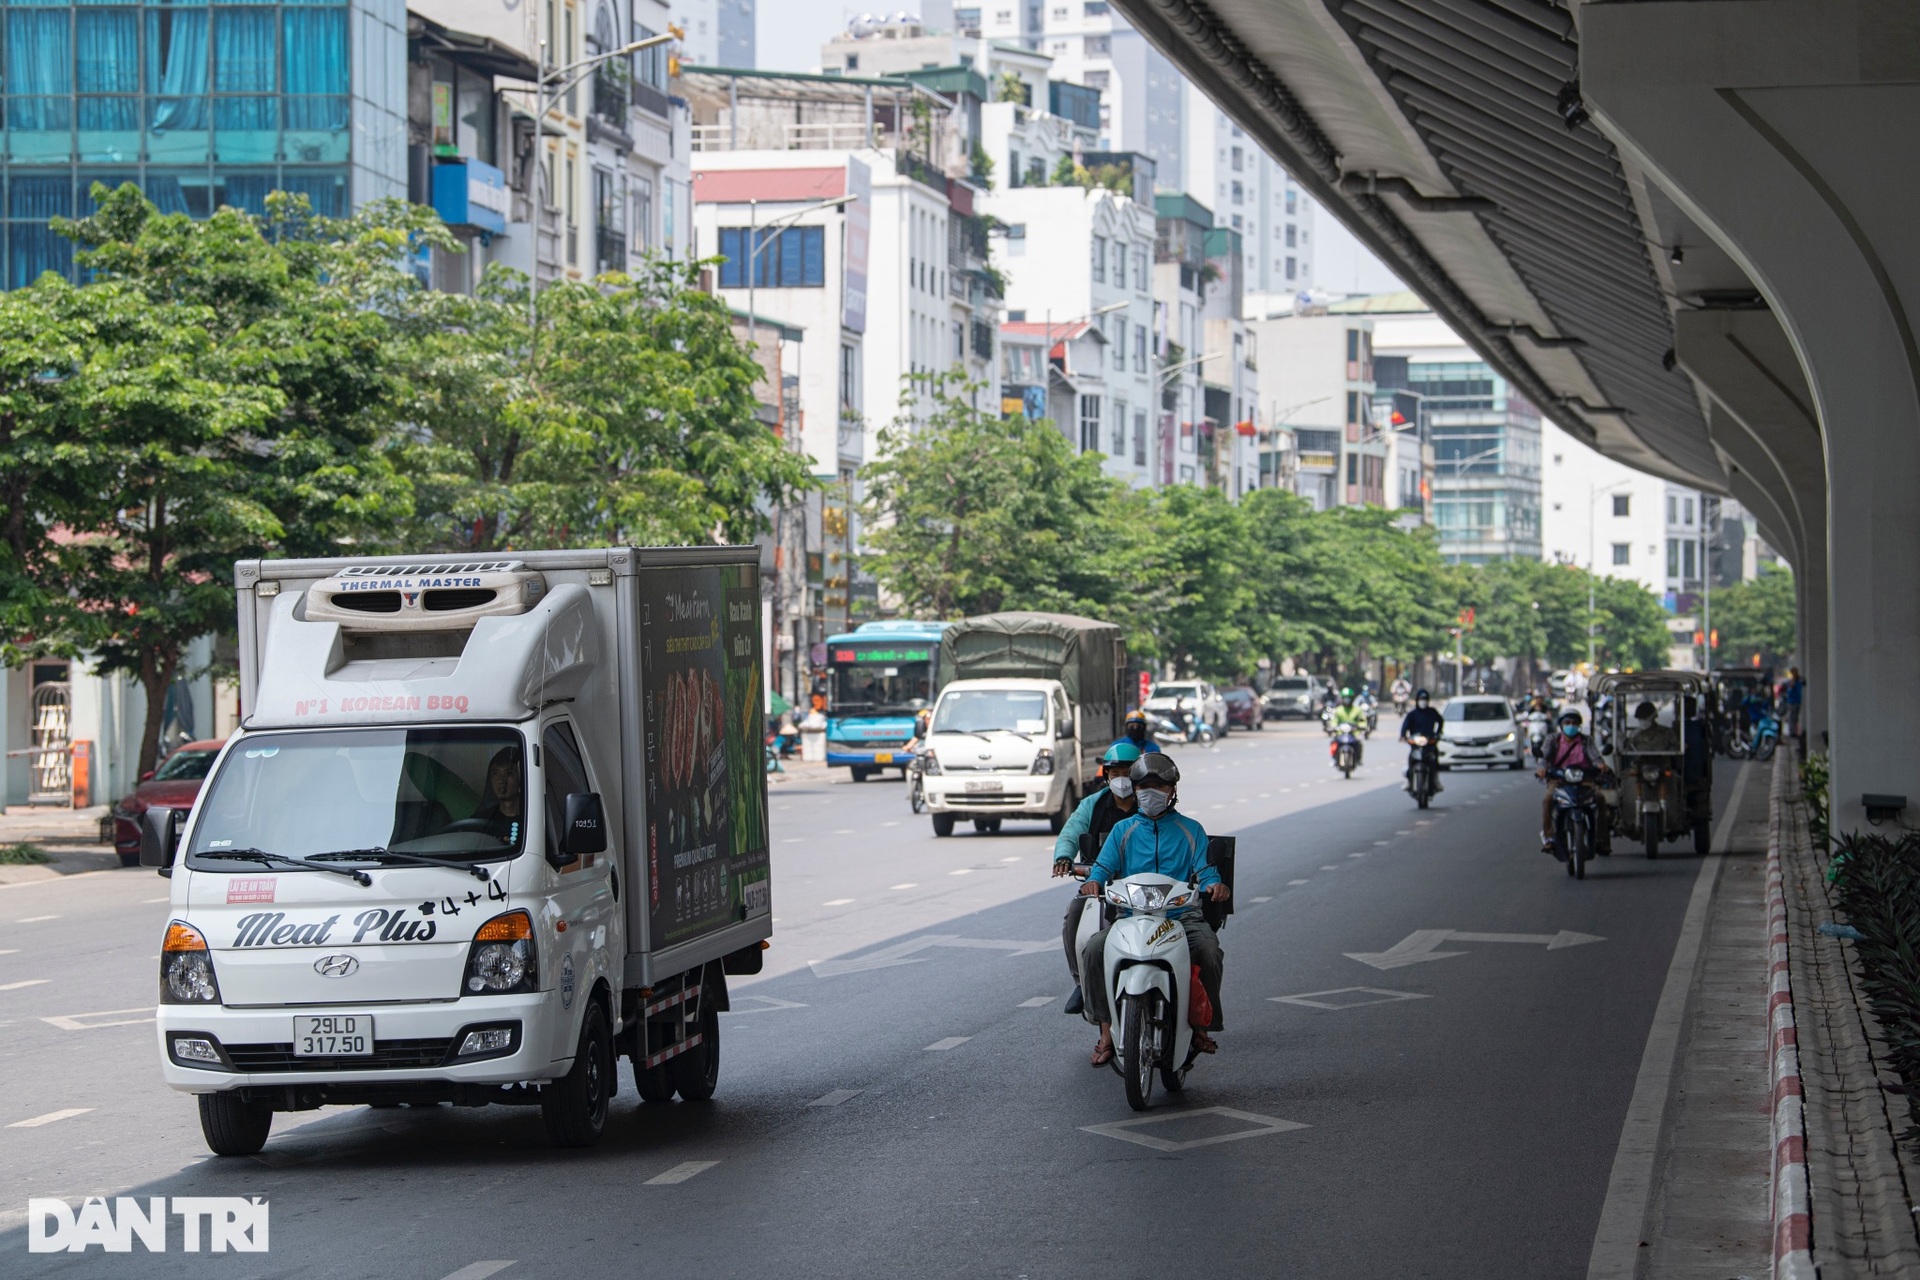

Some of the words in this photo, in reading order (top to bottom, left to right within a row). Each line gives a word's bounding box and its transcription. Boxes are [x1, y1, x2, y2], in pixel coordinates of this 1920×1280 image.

[340, 579, 413, 591] THERMAL
[418, 577, 481, 588] MASTER
[340, 696, 421, 713] KOREAN
[427, 695, 469, 714] BBQ
[232, 912, 342, 947] Meat
[351, 908, 437, 943] Plus
[1146, 919, 1175, 946] WAVE
[311, 1018, 355, 1034] 29LD
[303, 1036, 364, 1053] 317.50
